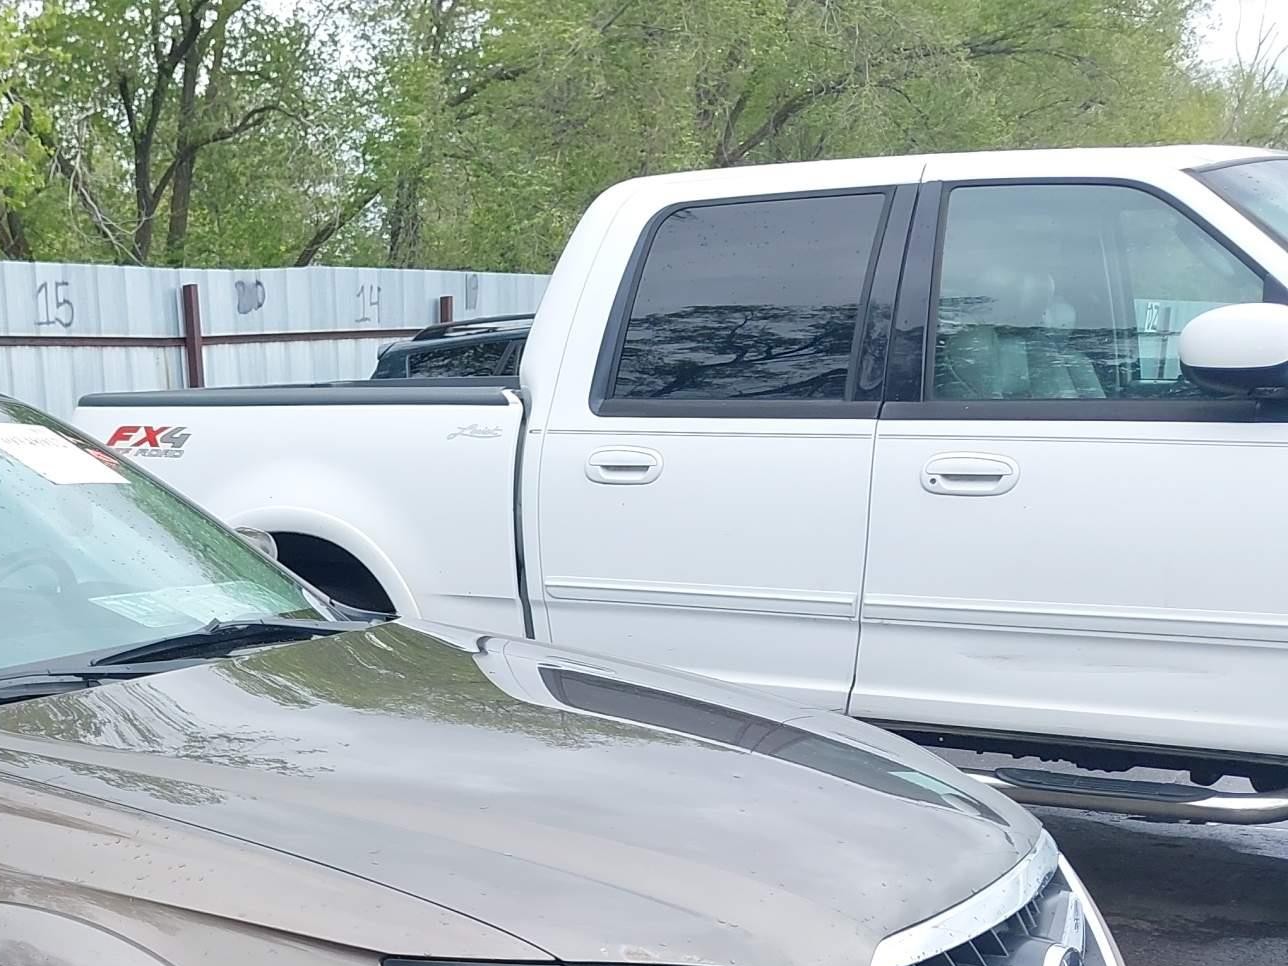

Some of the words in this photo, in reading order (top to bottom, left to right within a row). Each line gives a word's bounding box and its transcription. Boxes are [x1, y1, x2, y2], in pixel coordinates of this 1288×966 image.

[34, 281, 74, 328] 15
[355, 284, 381, 323] 14
[106, 425, 192, 449] FX4
[134, 448, 185, 459] ROAD
